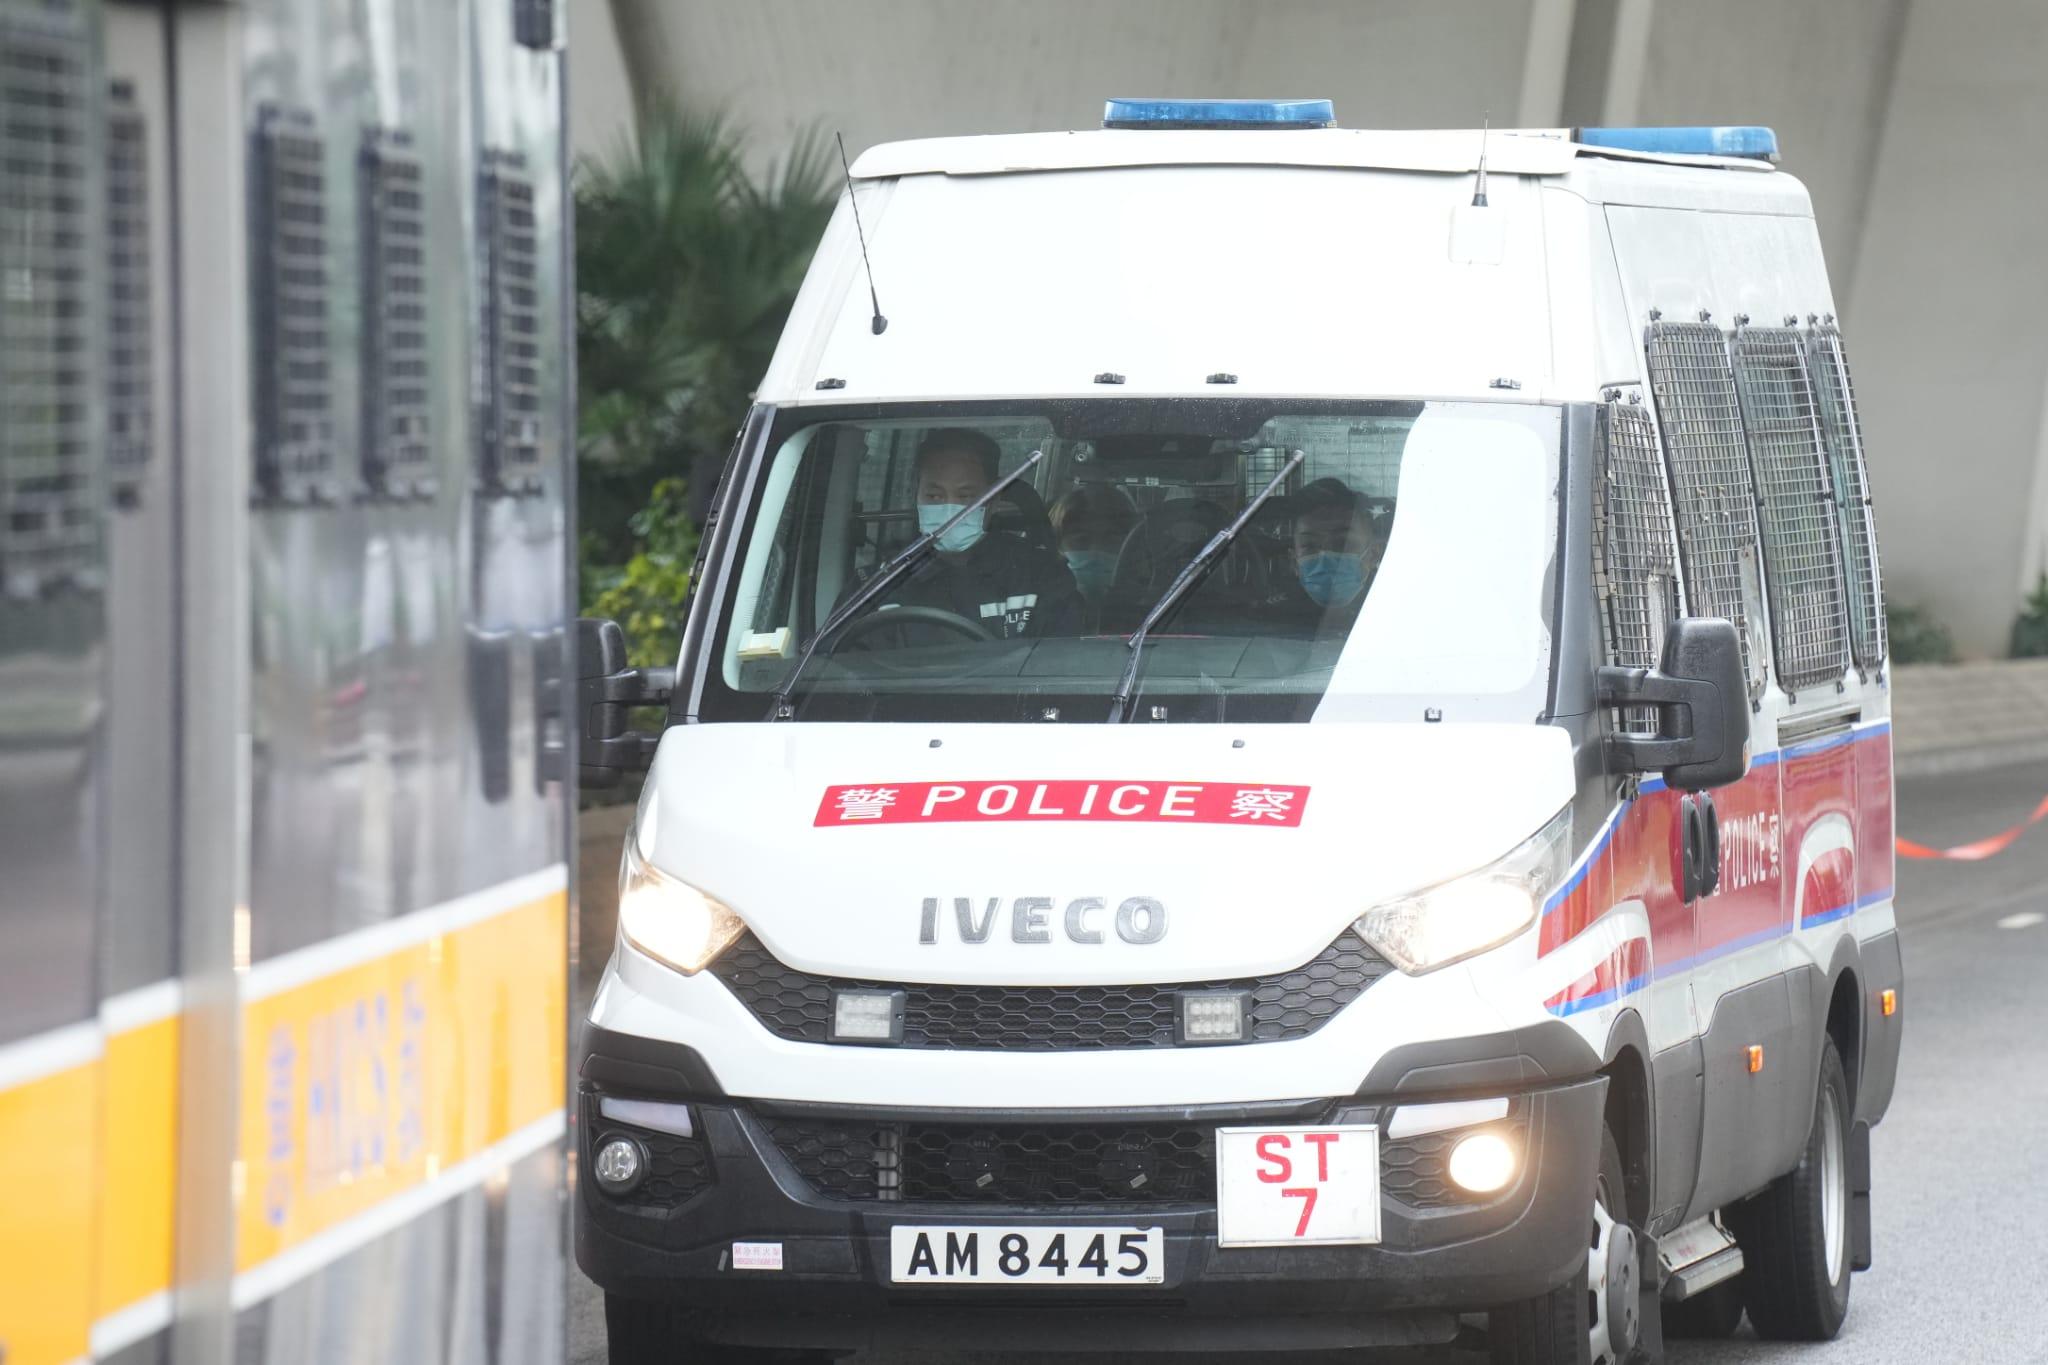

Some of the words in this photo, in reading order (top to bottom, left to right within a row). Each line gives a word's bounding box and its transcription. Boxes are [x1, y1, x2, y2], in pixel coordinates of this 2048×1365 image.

[834, 788, 899, 820] 警
[921, 784, 1204, 817] POLICE
[1228, 788, 1295, 821] 察
[1724, 811, 1766, 893] POLICE
[918, 896, 1169, 945] IVECO
[1256, 1134, 1339, 1184] ST
[1282, 1188, 1319, 1237] 7
[908, 1232, 979, 1277] AM
[999, 1233, 1148, 1277] 8445
